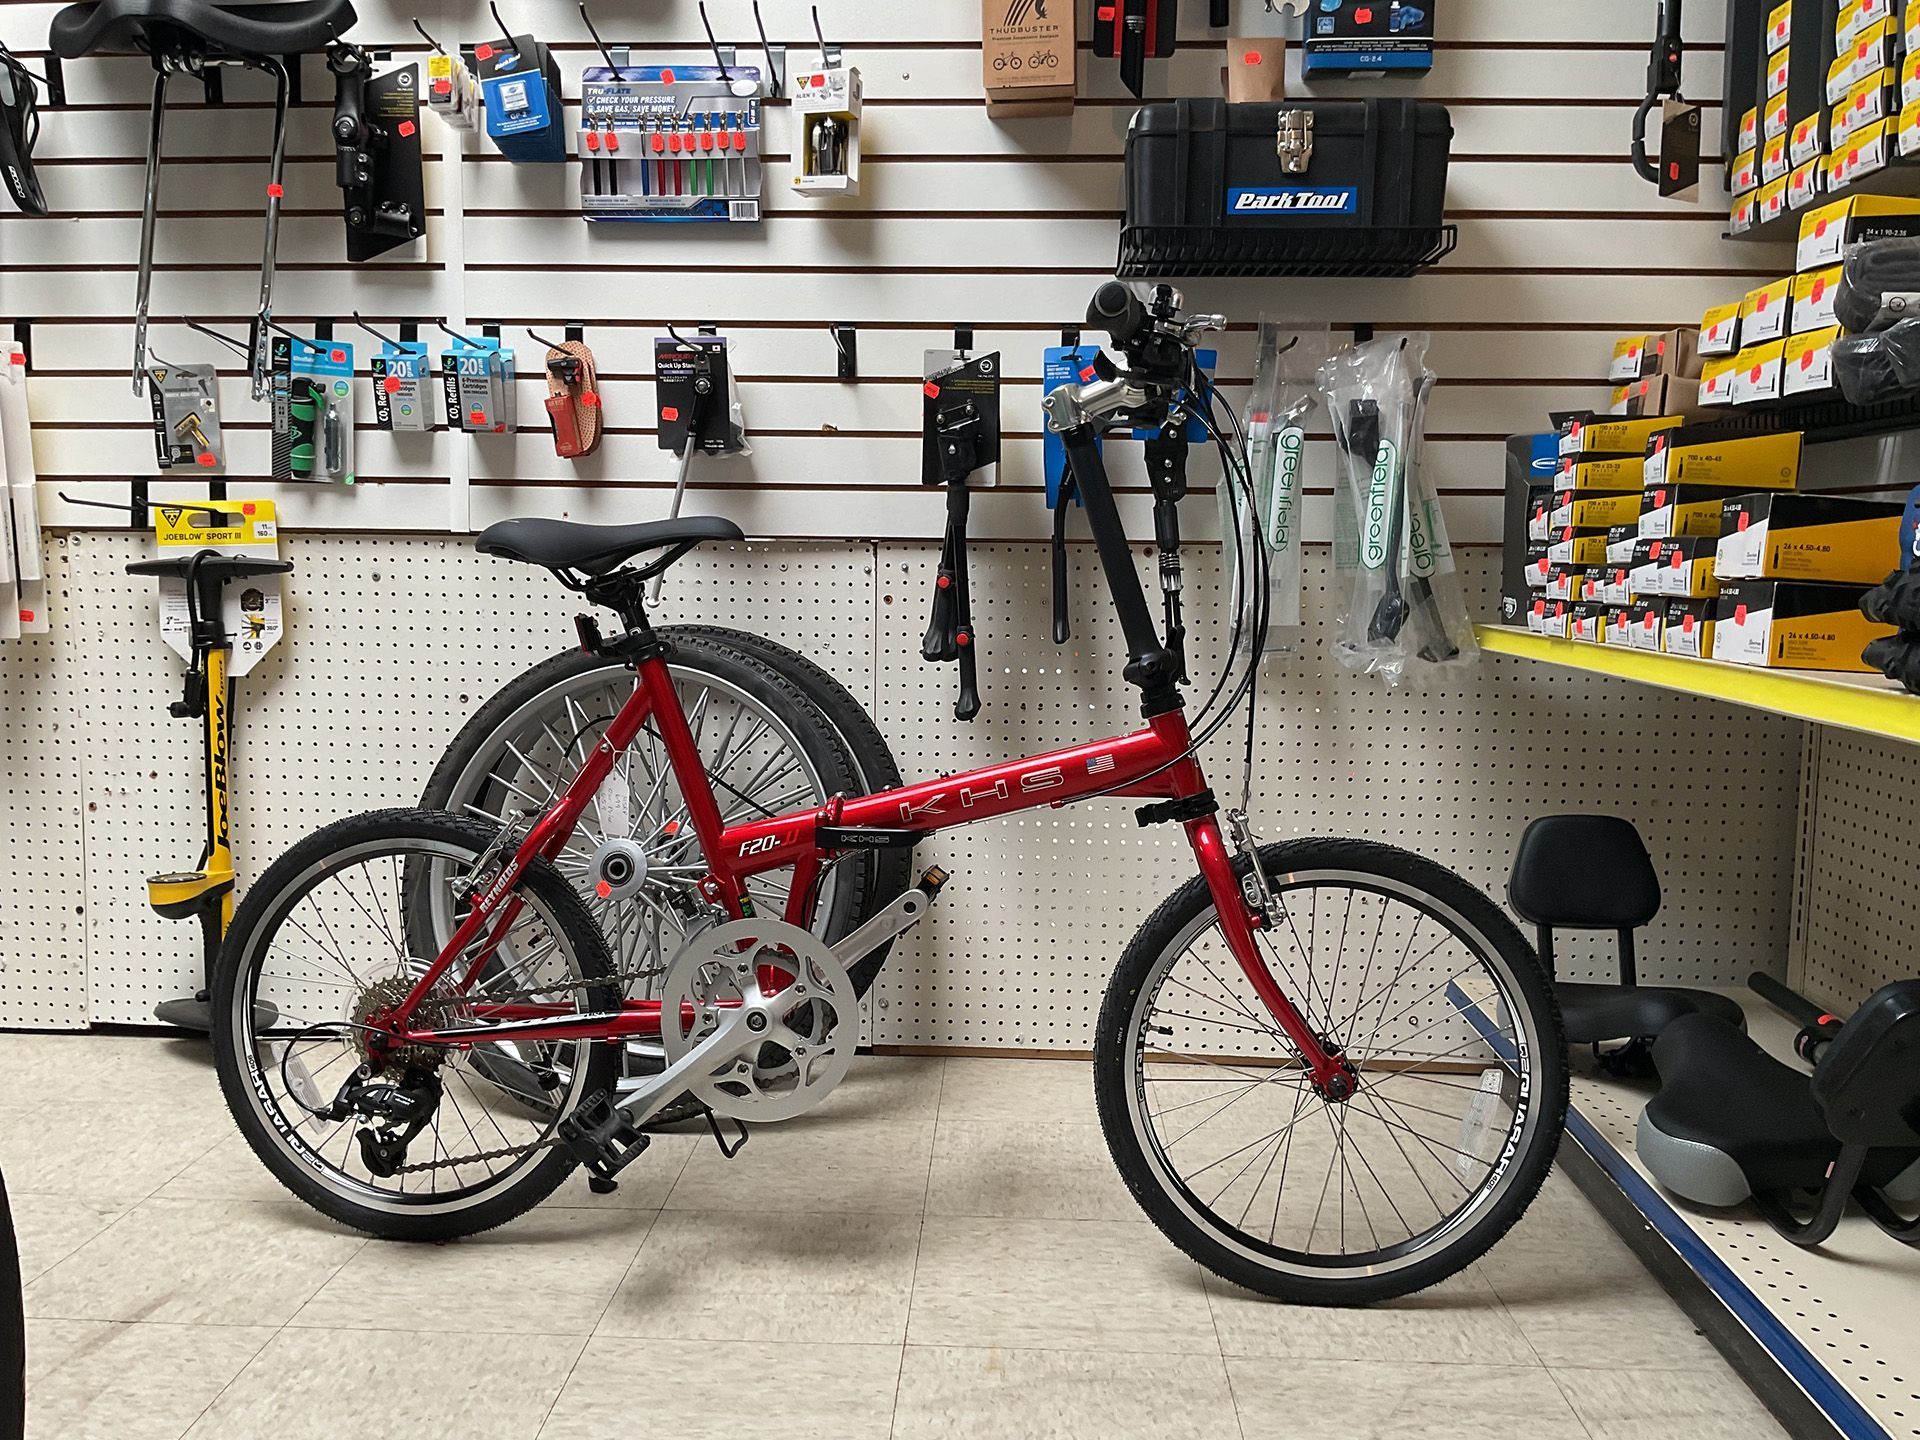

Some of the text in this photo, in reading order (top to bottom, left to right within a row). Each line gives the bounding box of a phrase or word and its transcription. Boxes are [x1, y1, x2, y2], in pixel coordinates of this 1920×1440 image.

[989, 25, 1060, 35] THUDBUSTER
[596, 96, 675, 104] CHECK YOUR PRESSURE
[594, 105, 676, 113] SAVE GAS, SAVE MONEY
[388, 360, 406, 377] 20
[460, 358, 478, 375] 20
[446, 376, 458, 404] Refills
[164, 532, 202, 541] JOEBLOW
[206, 532, 232, 540] SPORT
[1783, 542, 1792, 550] 26
[1799, 543, 1831, 552] 4.50-4.80
[1804, 632, 1836, 641] 4.50-4.80
[213, 694, 230, 853] JoeBlow
[899, 766, 1065, 823] KHS
[840, 834, 889, 844] KHS
[479, 860, 519, 913] REYNOLDS
